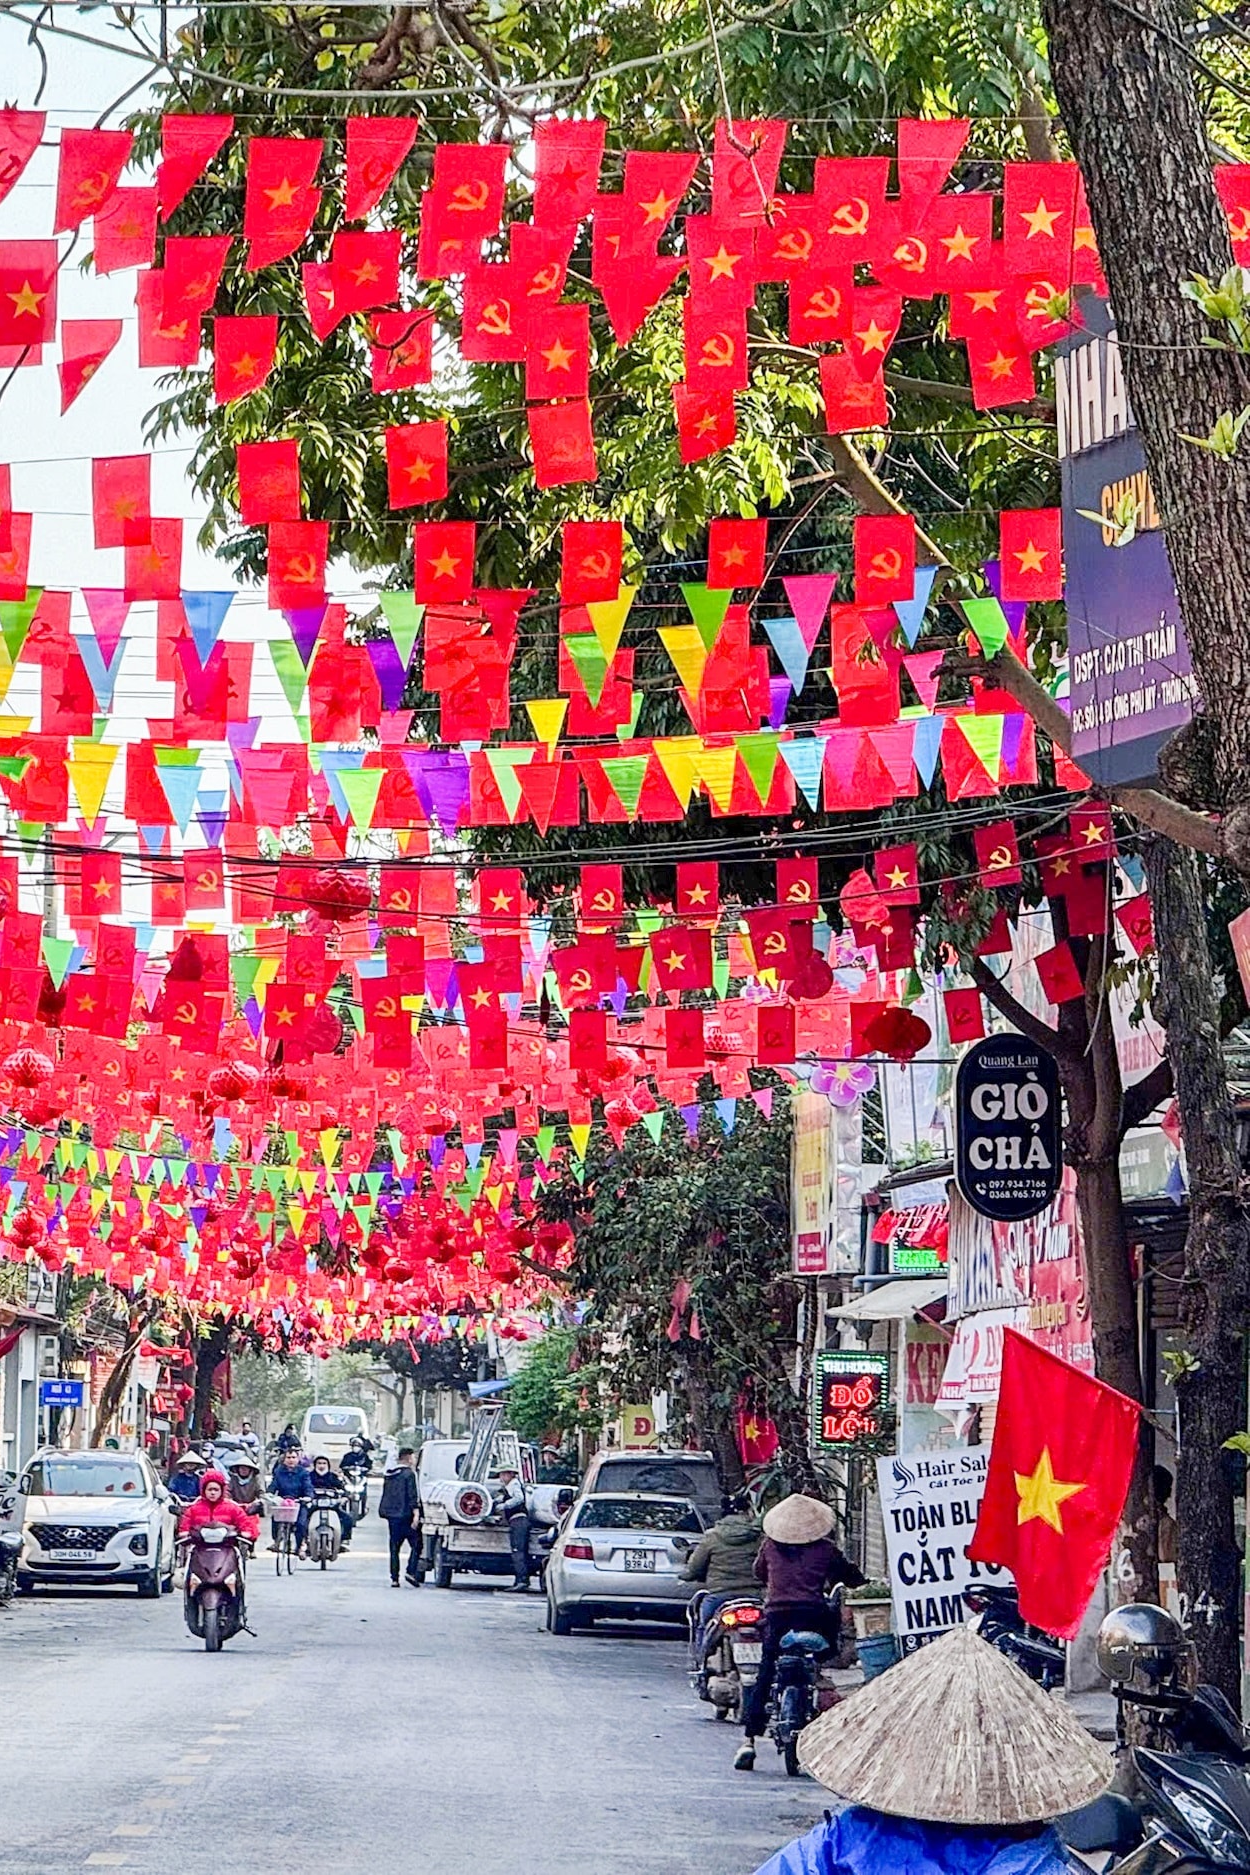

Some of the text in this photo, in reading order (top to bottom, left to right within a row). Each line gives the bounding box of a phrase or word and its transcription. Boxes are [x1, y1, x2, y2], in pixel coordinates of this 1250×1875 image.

[978, 1055, 1039, 1069] Quang Lan
[971, 1071, 1049, 1121] GIÒ
[969, 1123, 1051, 1171] CHẢ
[989, 1180, 1047, 1189] 097.934.7166
[989, 1190, 1047, 1199] 0368.965.769
[916, 1459, 956, 1478] Hair
[890, 1500, 946, 1533] TOÀN
[897, 1531, 955, 1586] CẮT
[905, 1593, 964, 1630] NAM
